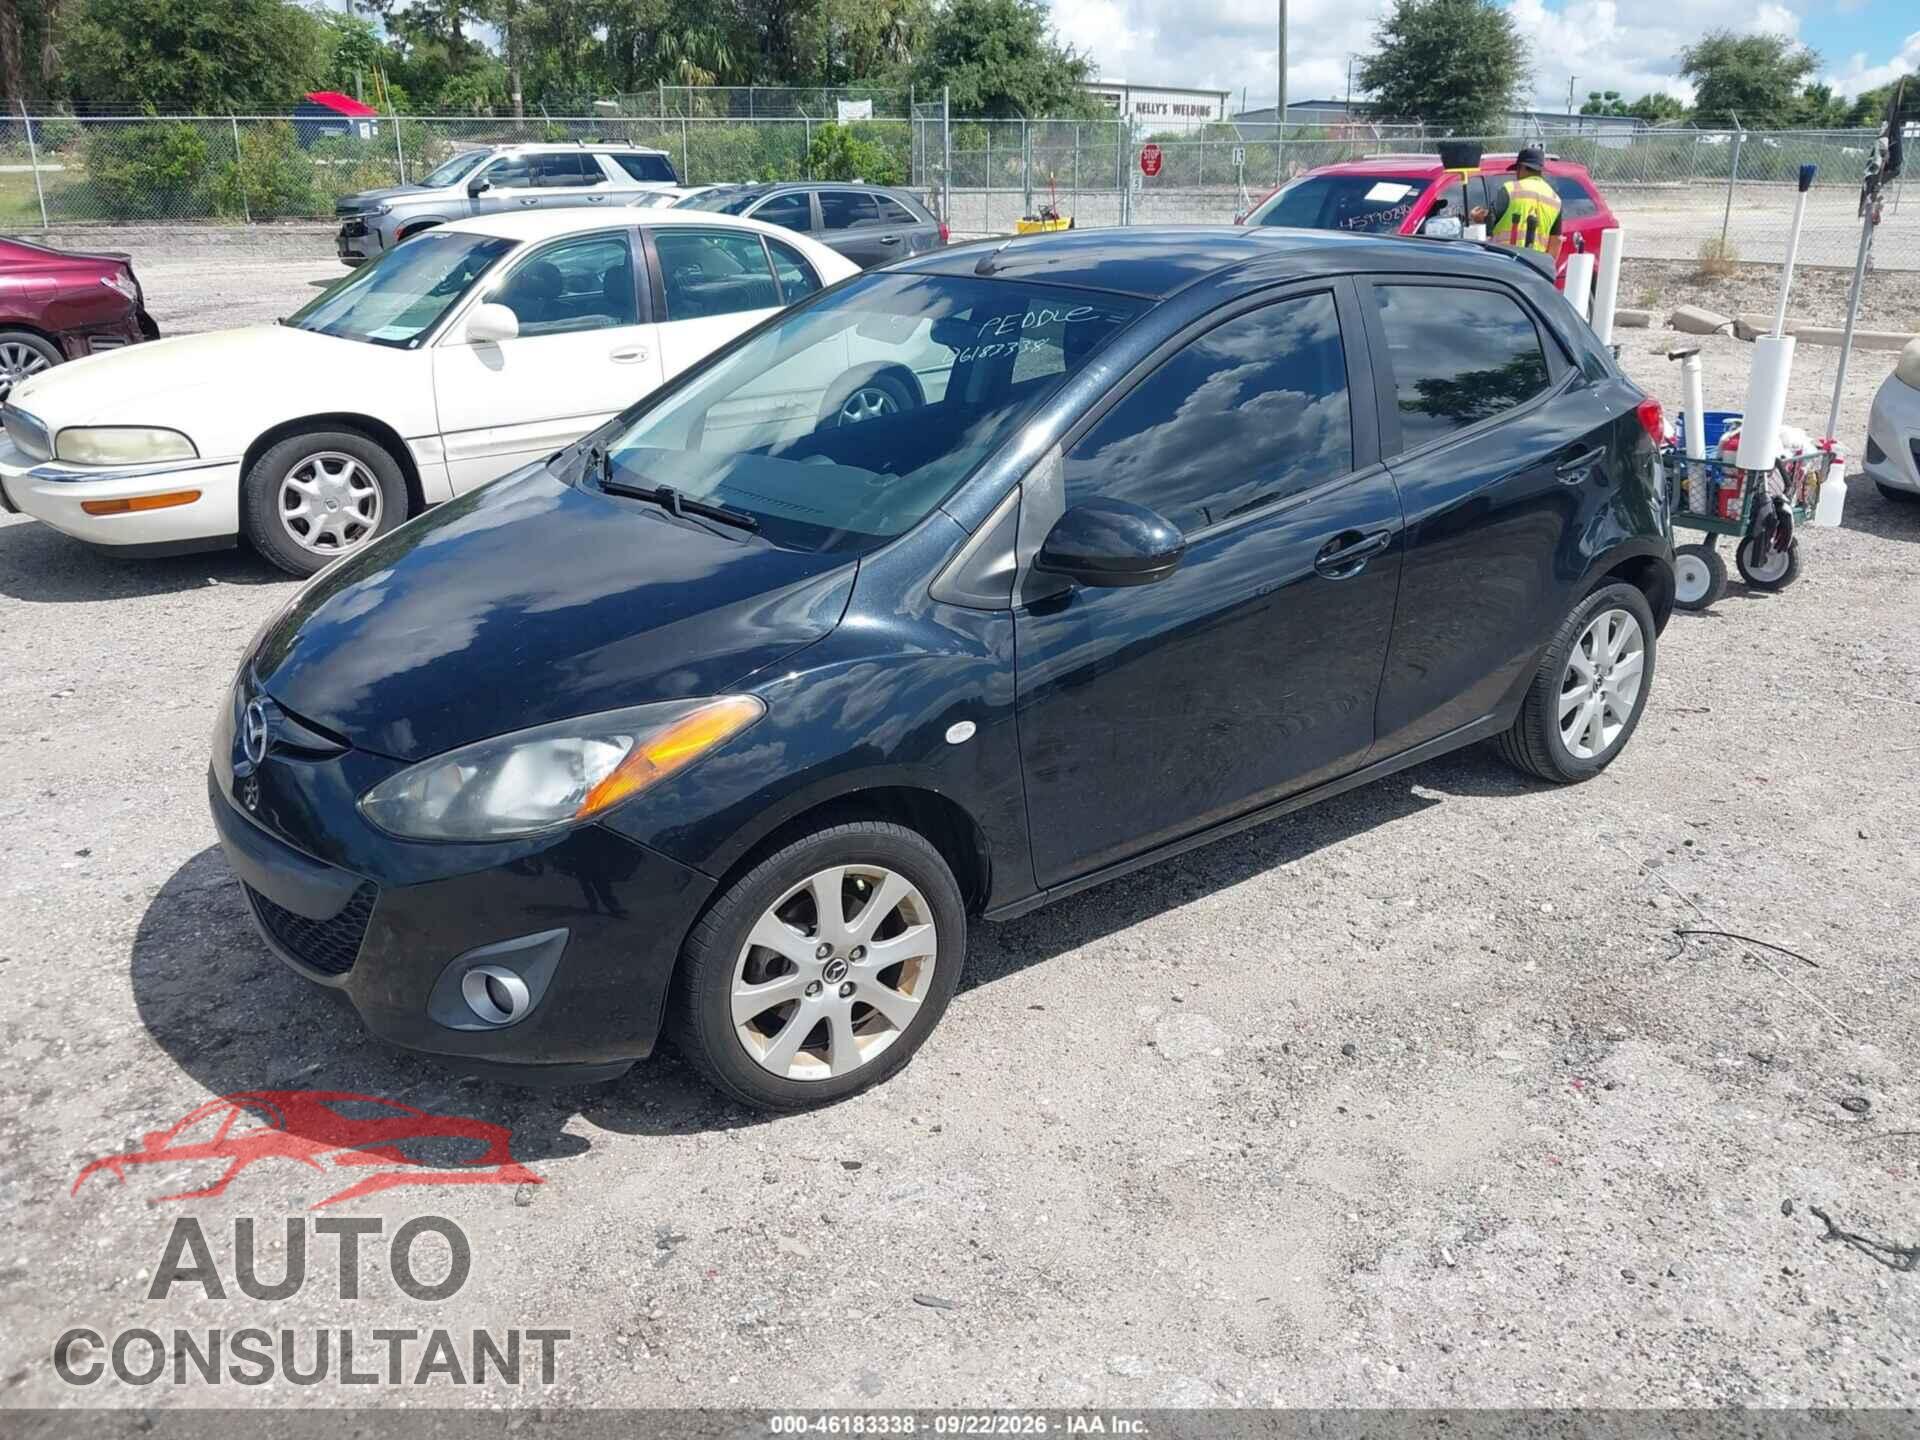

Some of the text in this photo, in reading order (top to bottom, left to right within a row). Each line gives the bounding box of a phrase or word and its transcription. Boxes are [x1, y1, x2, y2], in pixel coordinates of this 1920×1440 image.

[1136, 102, 1211, 117] KELLY'S WELDING
[1143, 149, 1159, 160] STOP
